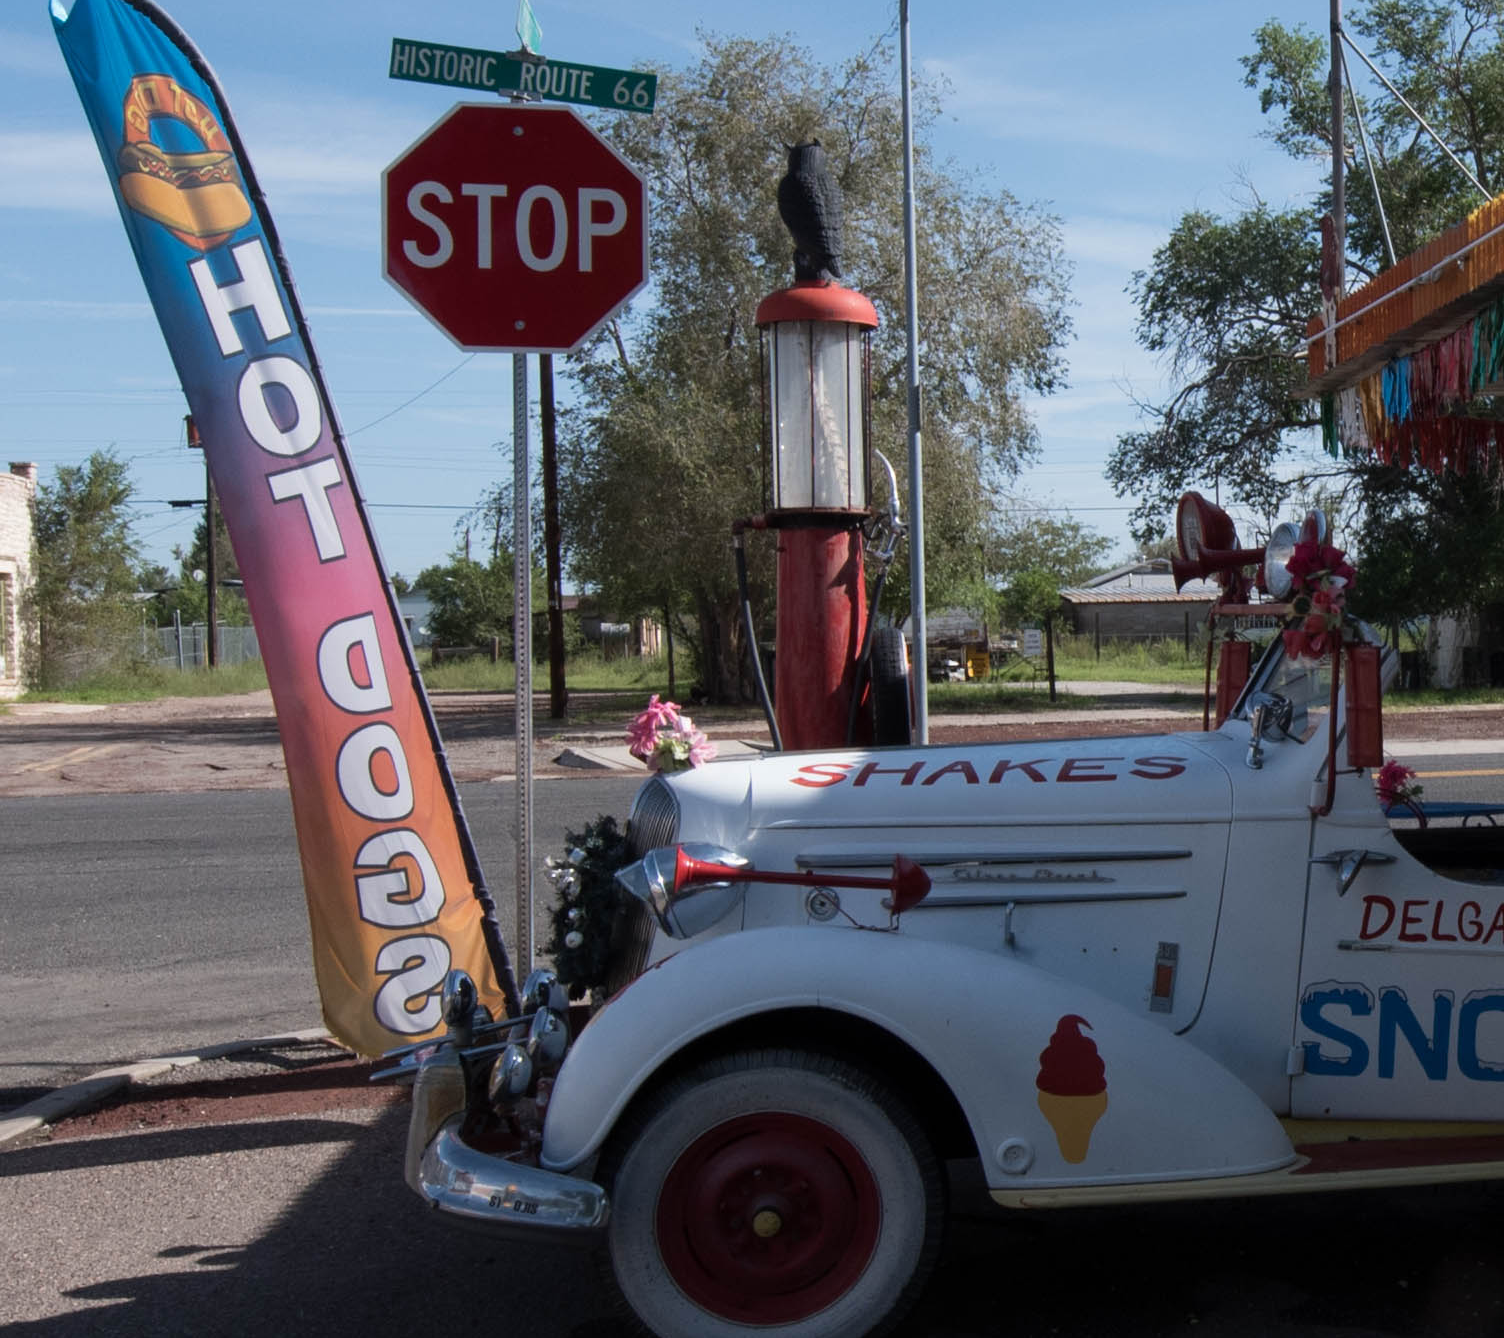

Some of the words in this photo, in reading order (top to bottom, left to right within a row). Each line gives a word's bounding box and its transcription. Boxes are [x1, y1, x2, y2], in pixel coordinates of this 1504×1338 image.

[393, 44, 497, 87] HISTORIC
[520, 62, 595, 101] ROUTE
[612, 77, 650, 109] 66
[402, 180, 628, 274] STOP
[789, 755, 1188, 788] SHAKES
